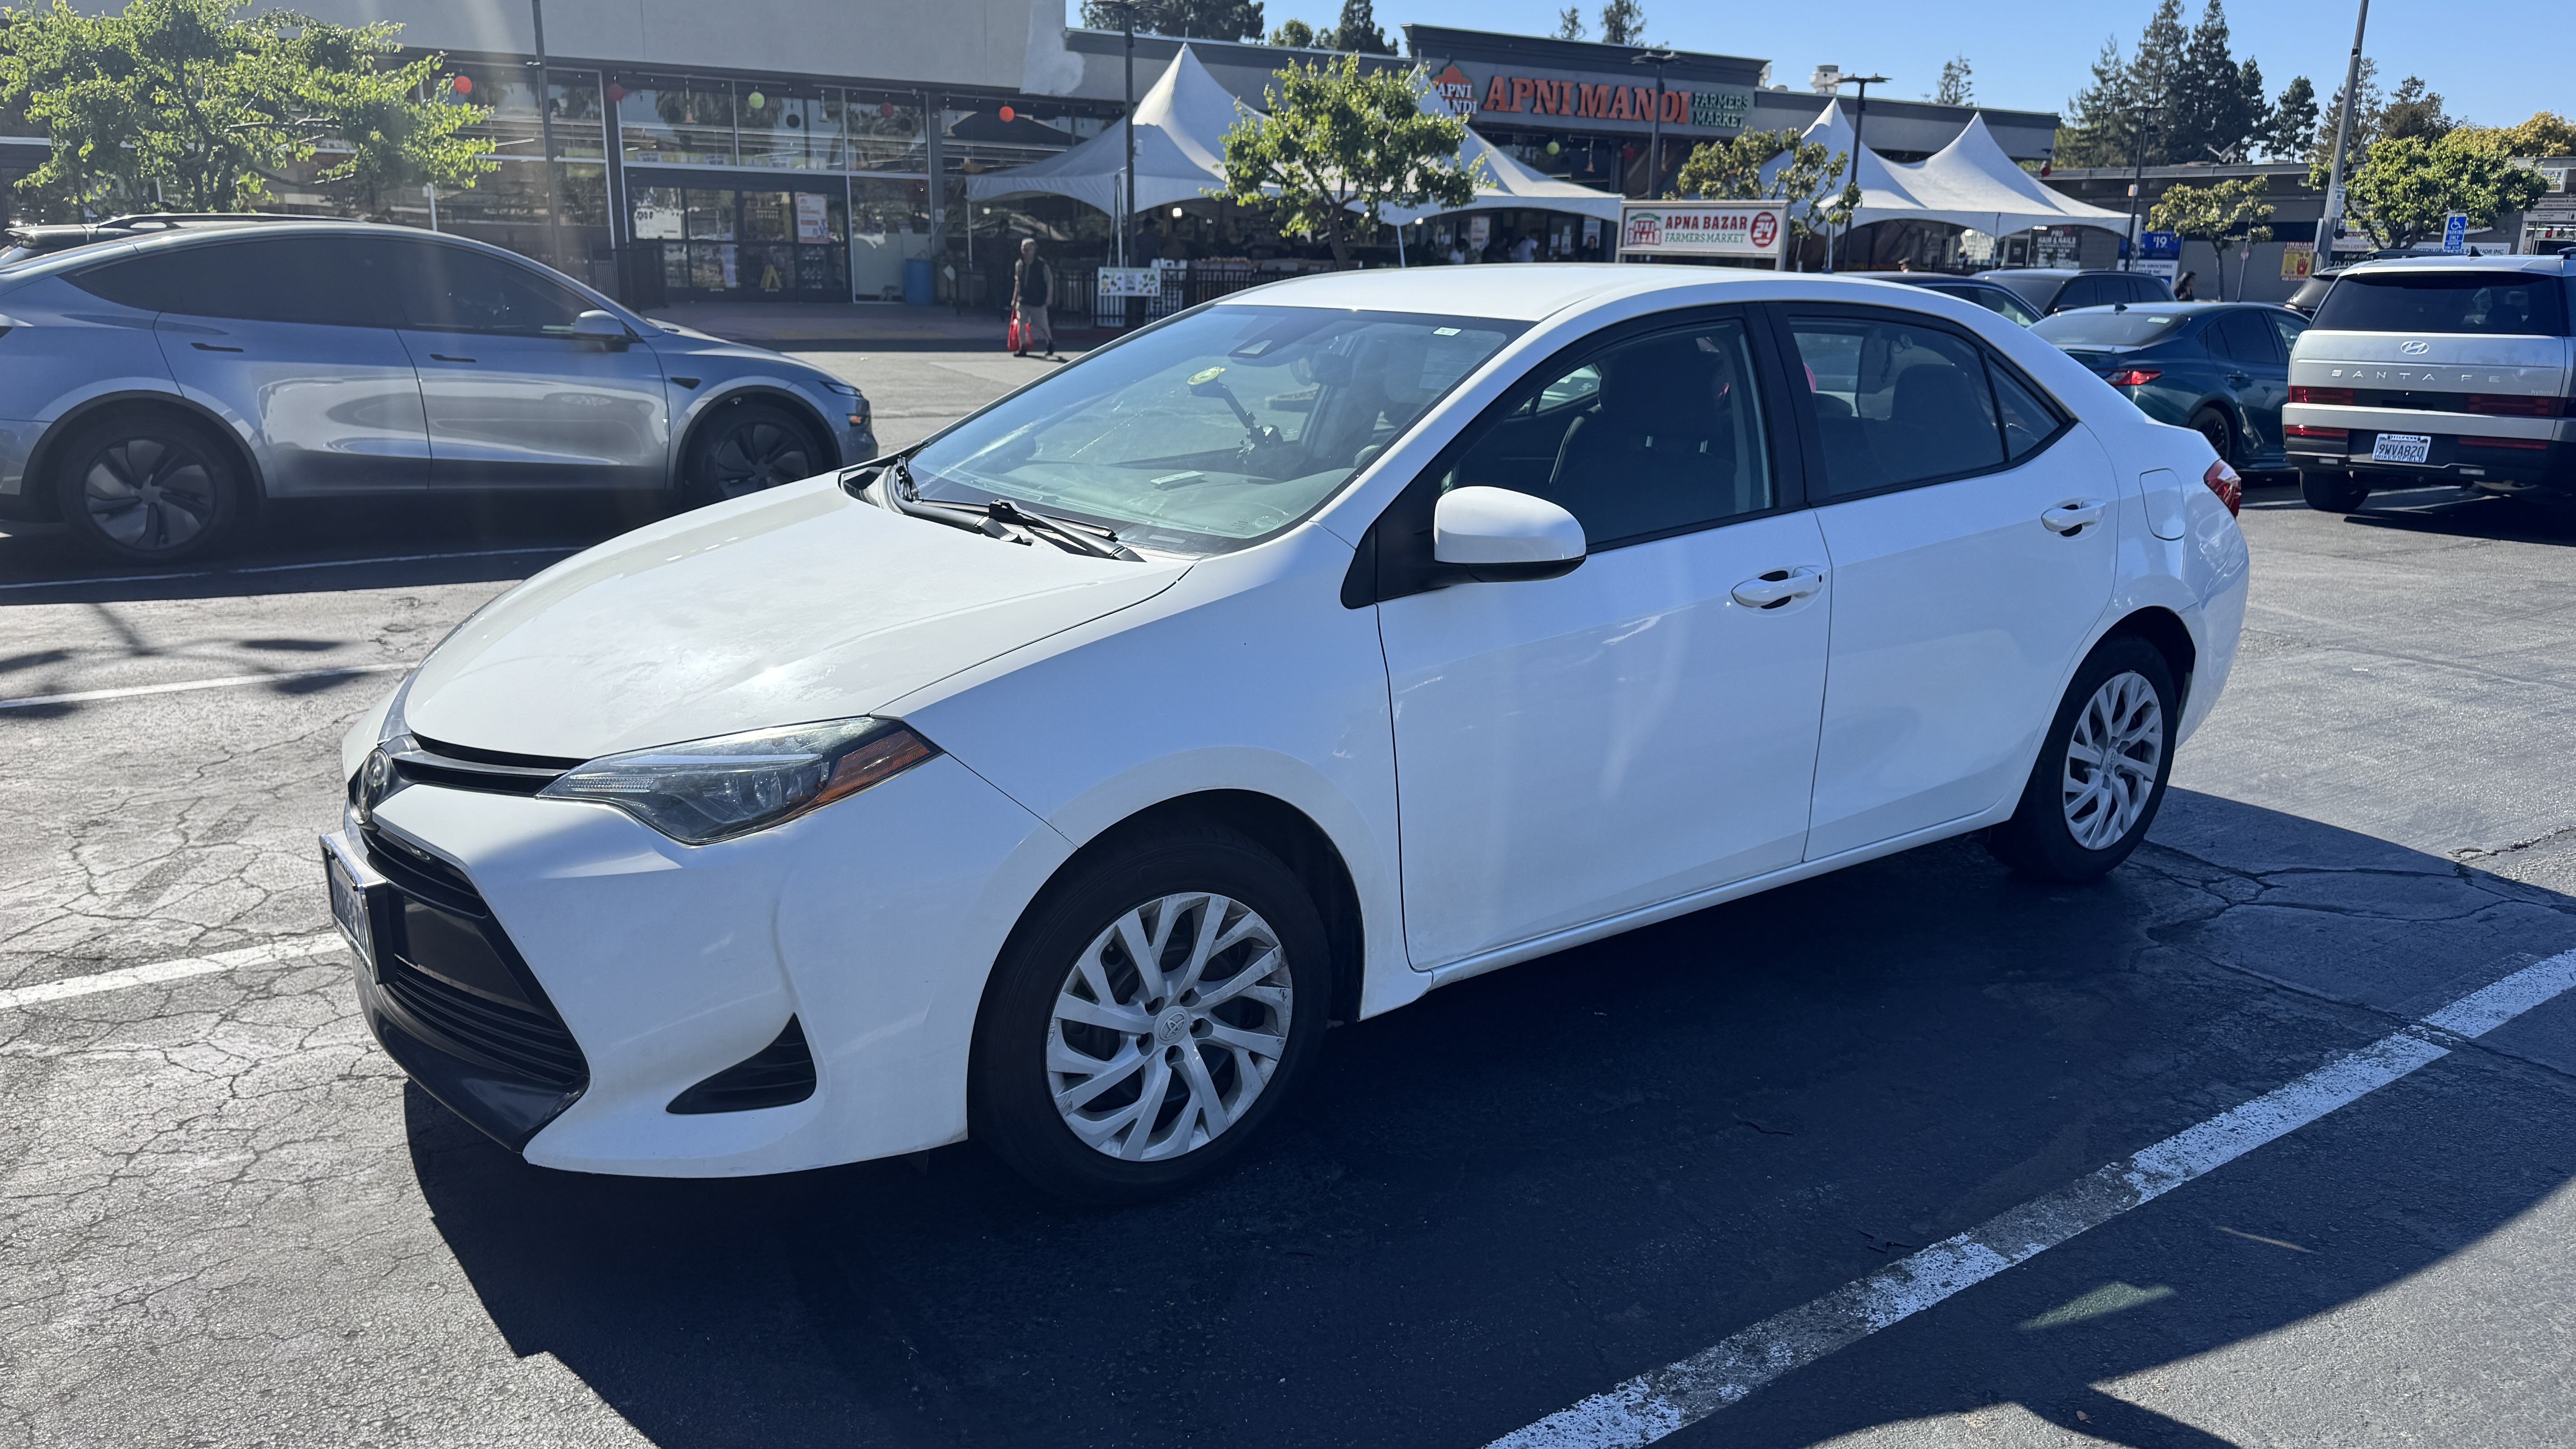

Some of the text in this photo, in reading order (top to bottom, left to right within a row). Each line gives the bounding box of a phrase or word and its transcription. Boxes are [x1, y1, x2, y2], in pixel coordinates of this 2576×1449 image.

[1438, 83, 1472, 98] APNI
[1483, 75, 1691, 124] APNI MANDI
[1693, 93, 1749, 110] FARMERS
[1693, 111, 1745, 128] MARKET
[1665, 216, 1748, 230] APNA BAZAR
[1753, 221, 1775, 238] 24
[1665, 232, 1745, 243] FARMERS MARKET
[2332, 369, 2500, 383] SANTA FE
[2378, 443, 2424, 457] 9WVA820
